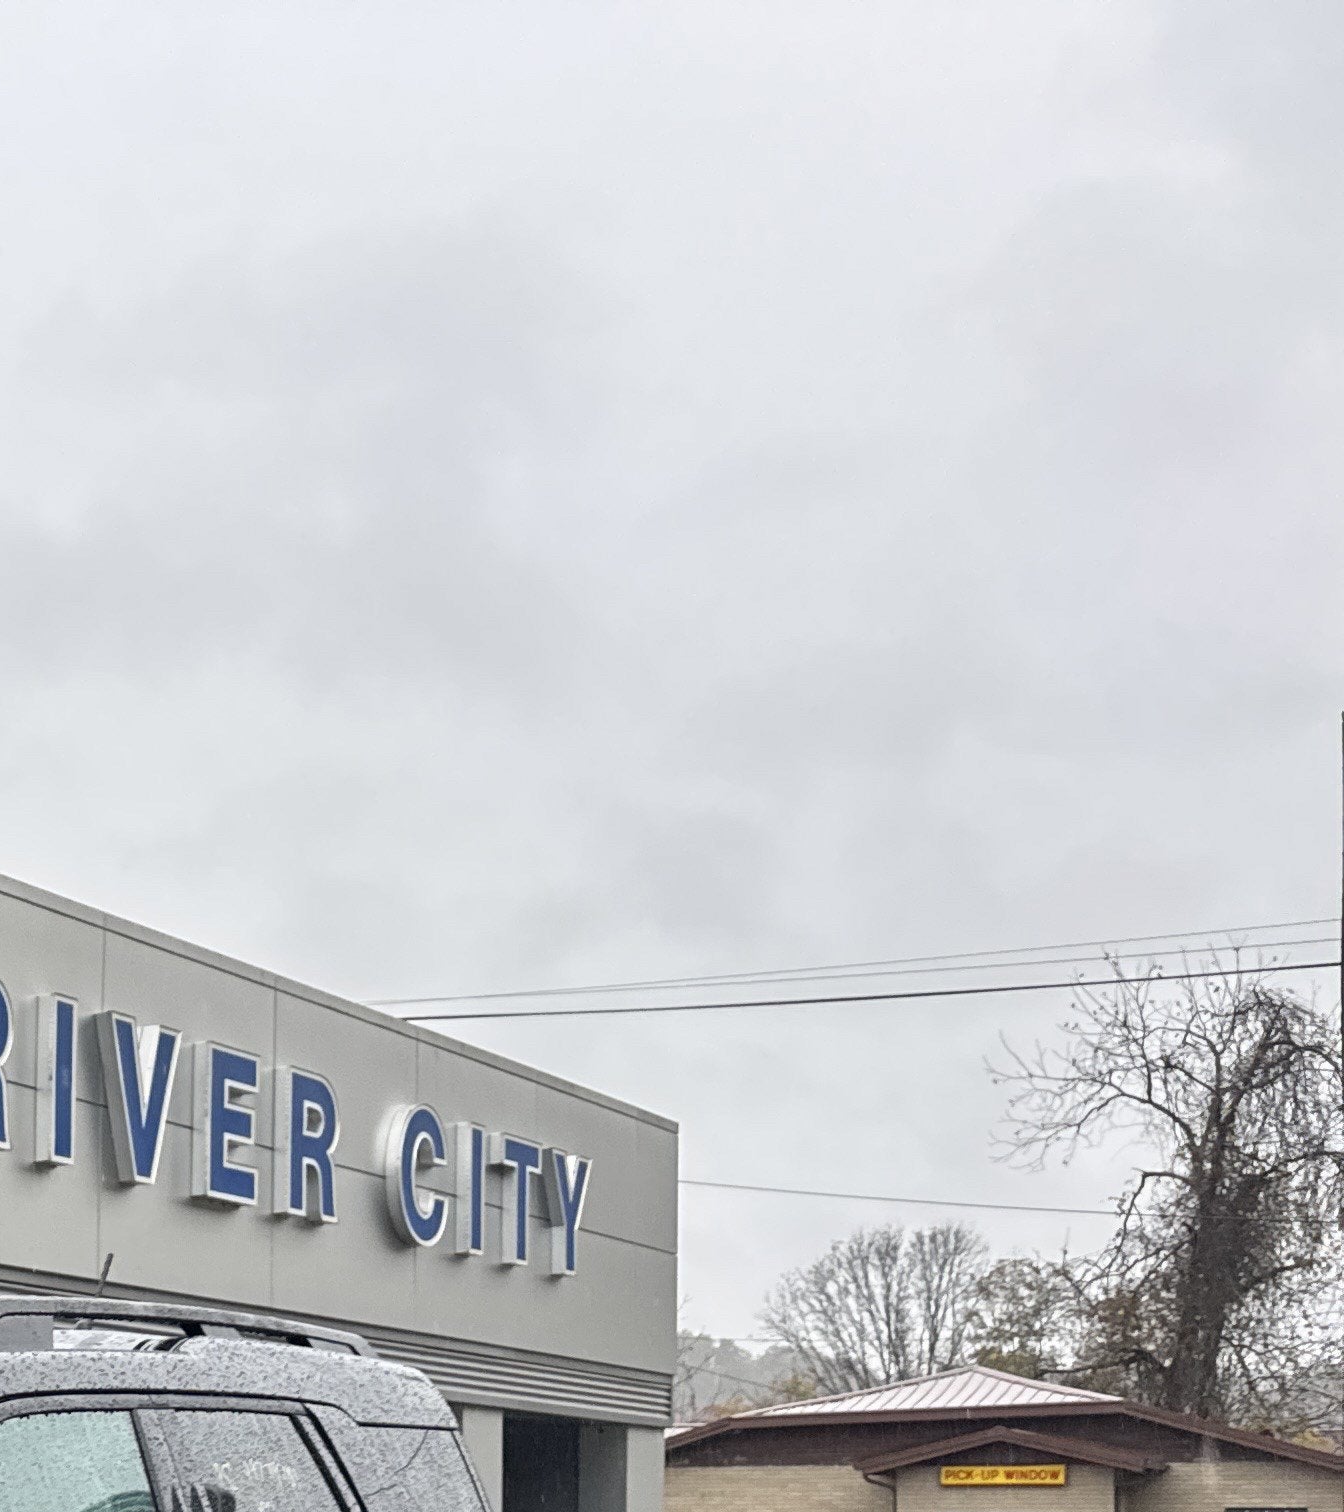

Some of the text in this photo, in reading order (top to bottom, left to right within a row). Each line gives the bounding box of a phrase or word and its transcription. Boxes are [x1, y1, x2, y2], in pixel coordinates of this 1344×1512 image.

[389, 1102, 593, 1276] CITY
[944, 1469, 1061, 1481] PICK-UP WINDOW
